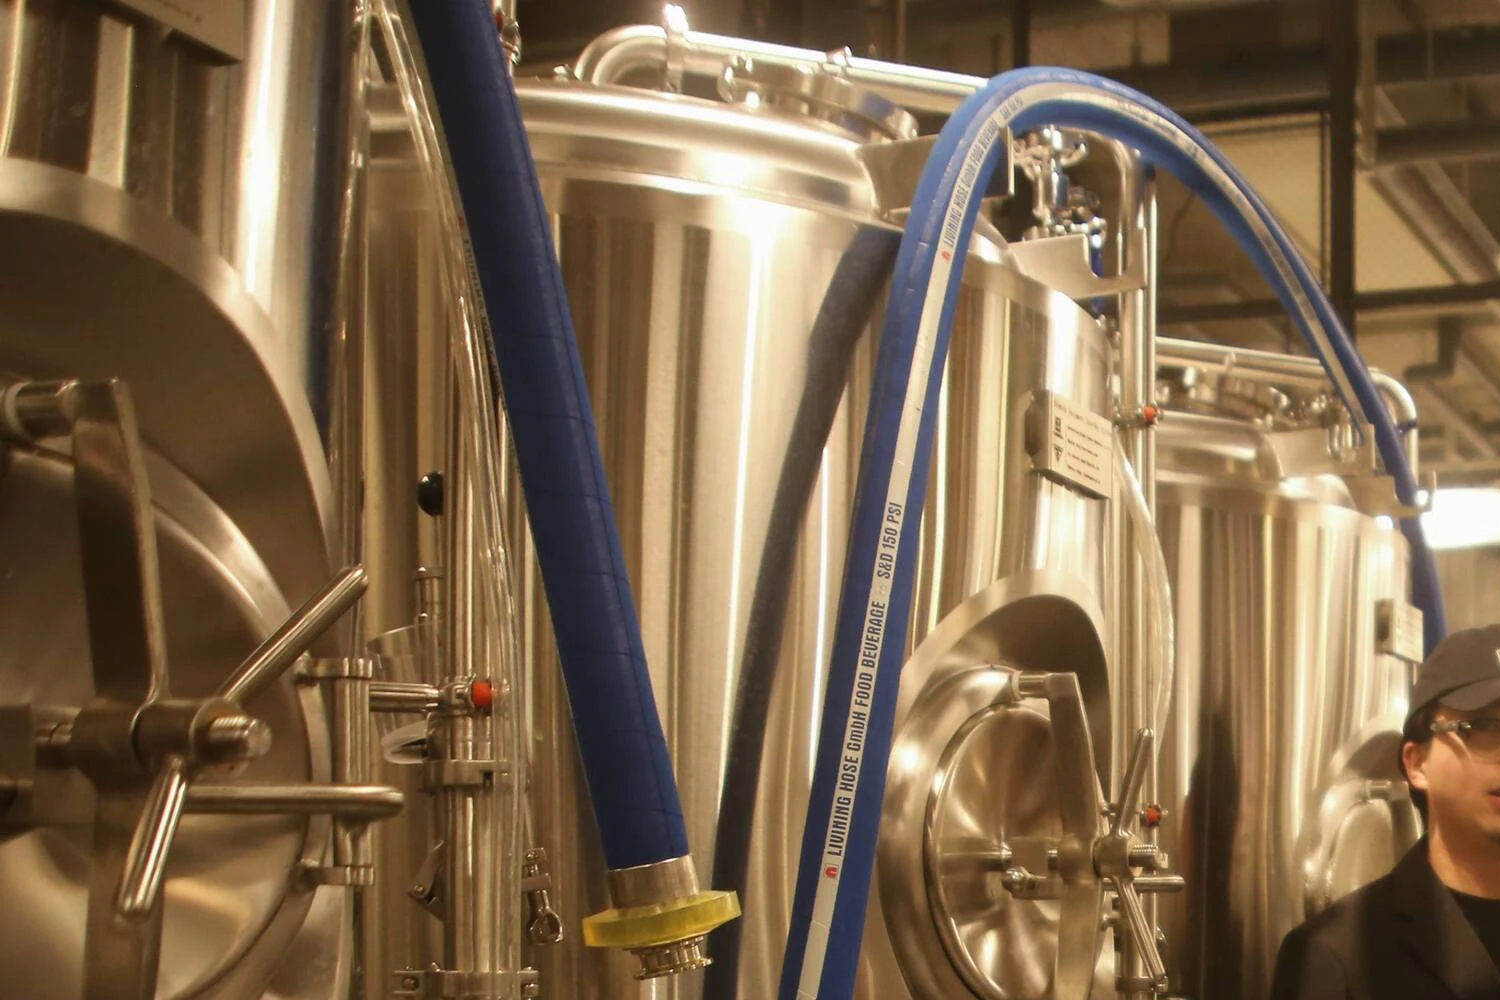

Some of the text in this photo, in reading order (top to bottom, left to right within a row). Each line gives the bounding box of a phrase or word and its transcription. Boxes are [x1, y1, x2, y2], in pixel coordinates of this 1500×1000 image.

[827, 502, 902, 857] LIVINING HOSE GmbH FOOD BEVERAGE S&D 150 PSI
